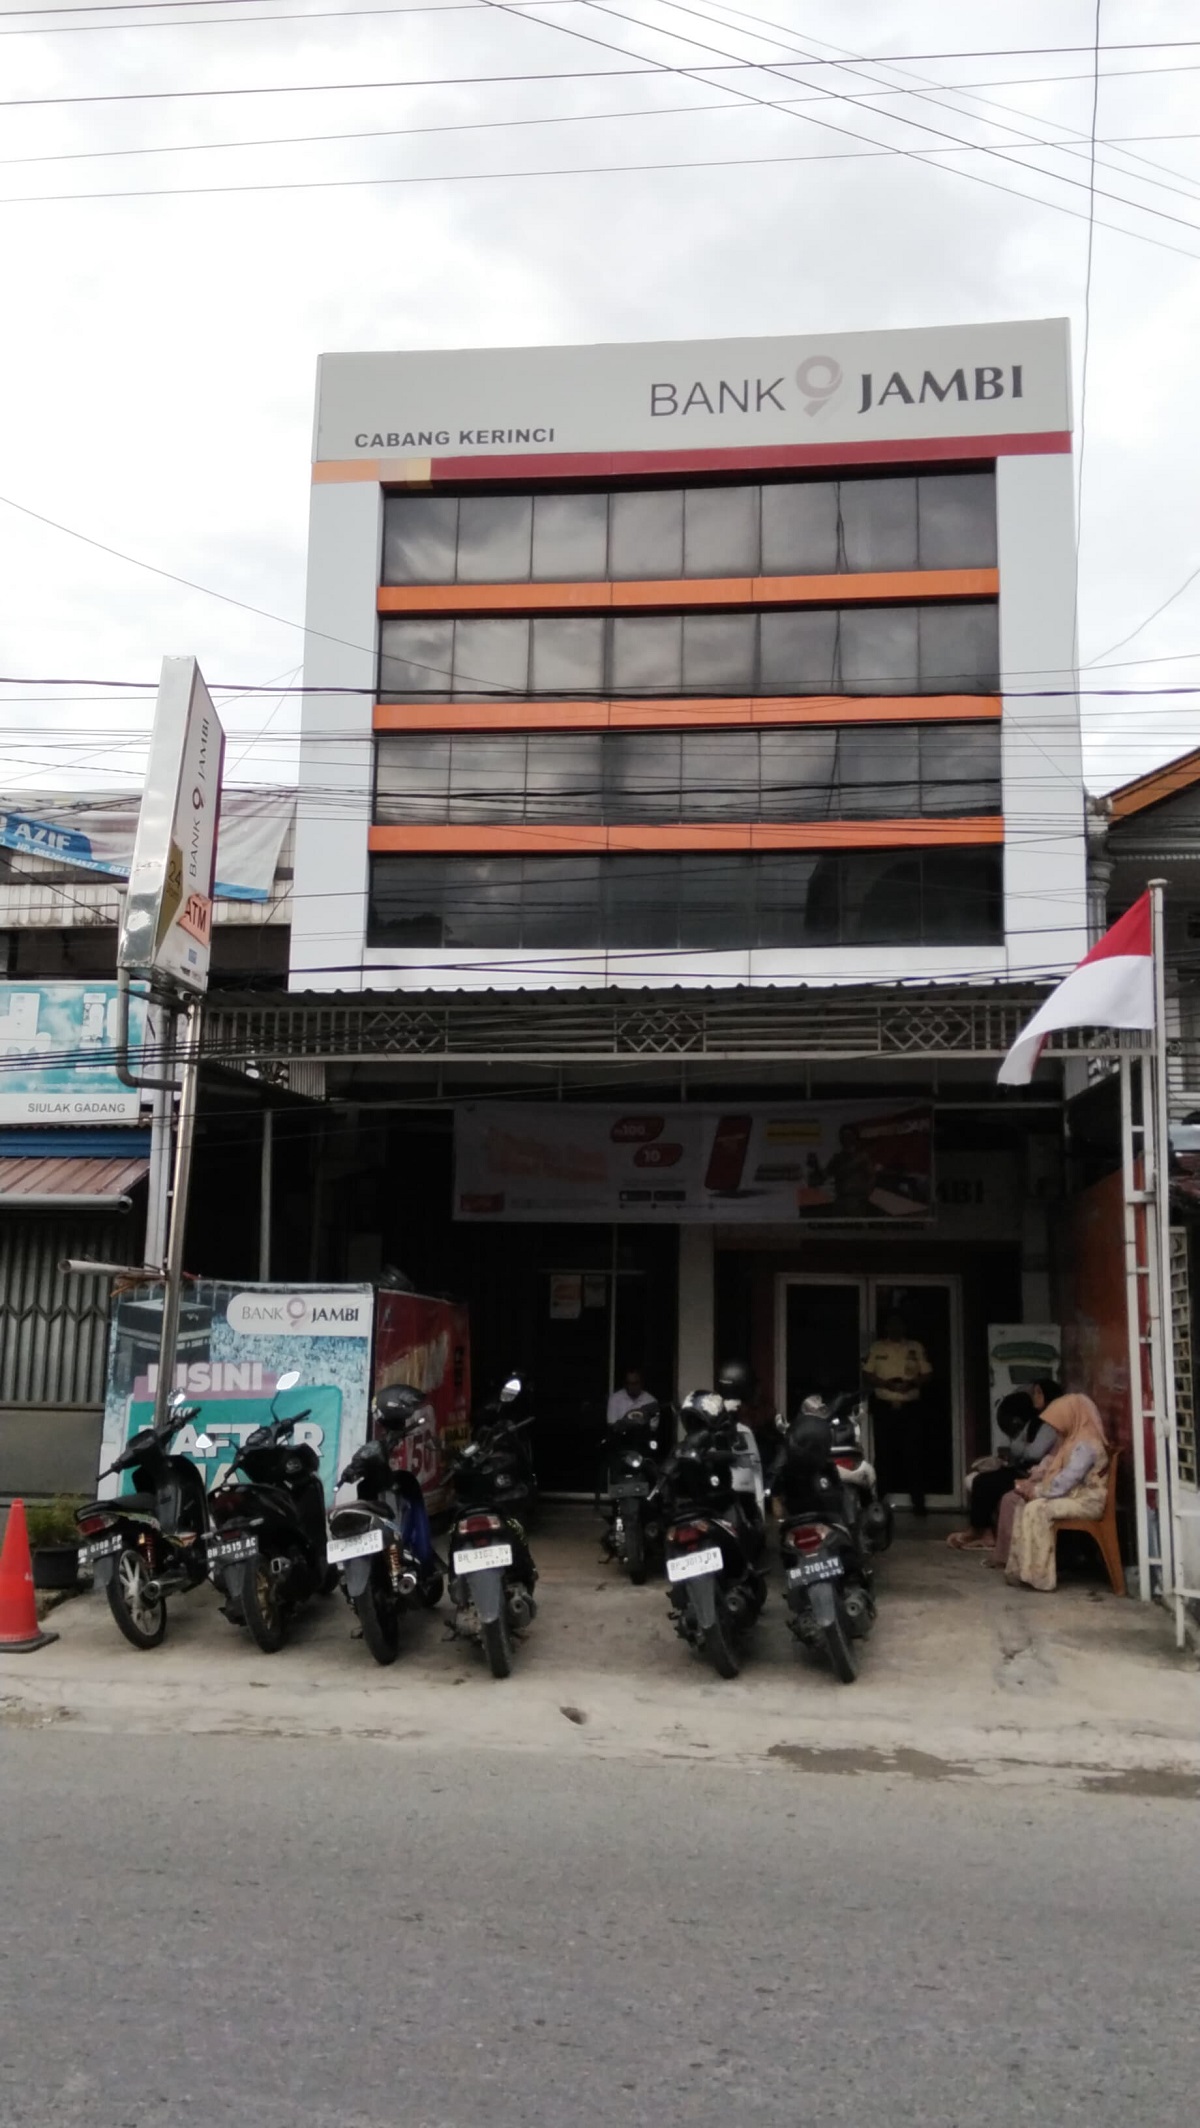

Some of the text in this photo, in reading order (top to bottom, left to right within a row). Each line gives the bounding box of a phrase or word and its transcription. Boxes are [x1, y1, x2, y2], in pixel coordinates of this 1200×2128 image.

[650, 377, 786, 417] BANK
[857, 364, 1024, 414] JAMBI
[355, 428, 556, 448] CABANG KERINCI
[189, 817, 201, 877] BANK
[198, 718, 210, 781] JAMBI
[13, 815, 72, 851] AZIF
[169, 860, 181, 888] 24
[185, 900, 207, 933] ATM
[27, 1102, 126, 1114] SIULAK GADANG
[242, 1306, 283, 1320] BANK
[311, 1307, 360, 1323] JAMBI
